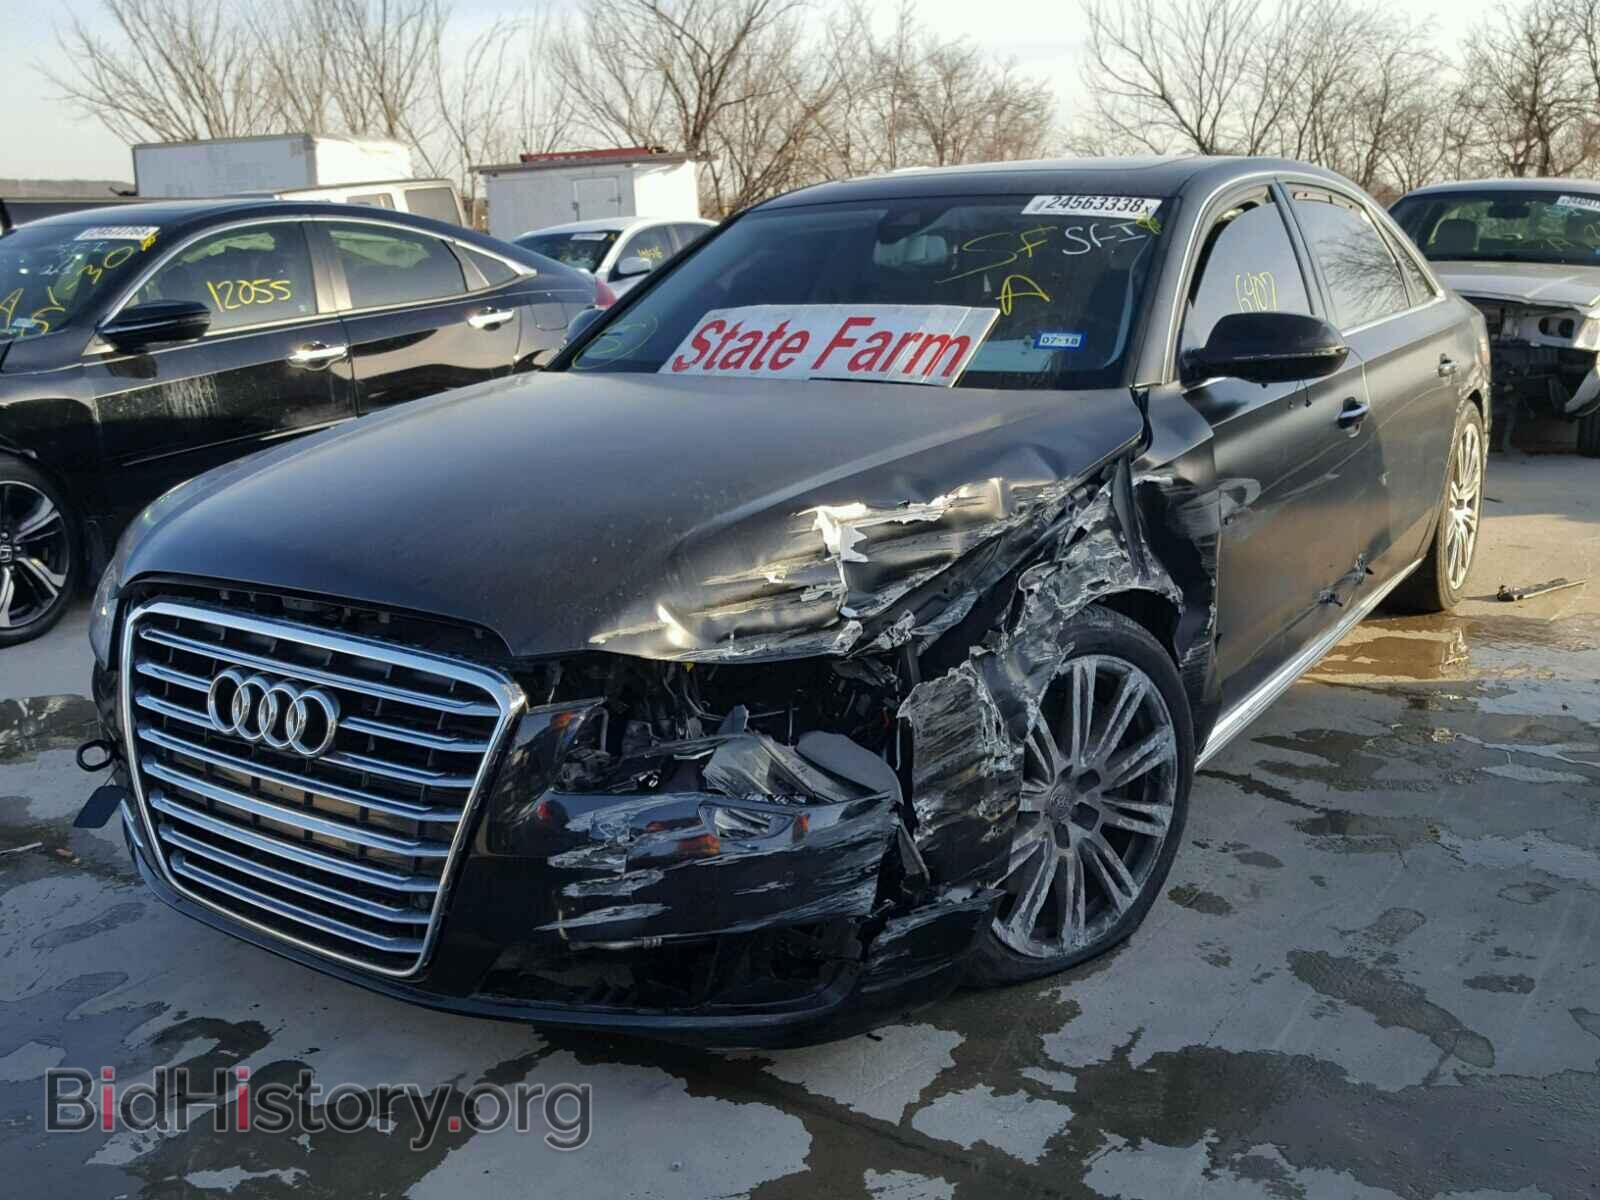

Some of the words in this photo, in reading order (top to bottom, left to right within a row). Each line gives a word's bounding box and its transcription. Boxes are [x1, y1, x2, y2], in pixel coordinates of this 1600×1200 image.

[1047, 195, 1145, 213] 24563338
[206, 278, 291, 312] 12055
[995, 274, 1051, 316] A
[672, 320, 810, 372] State
[811, 316, 971, 377] Farm
